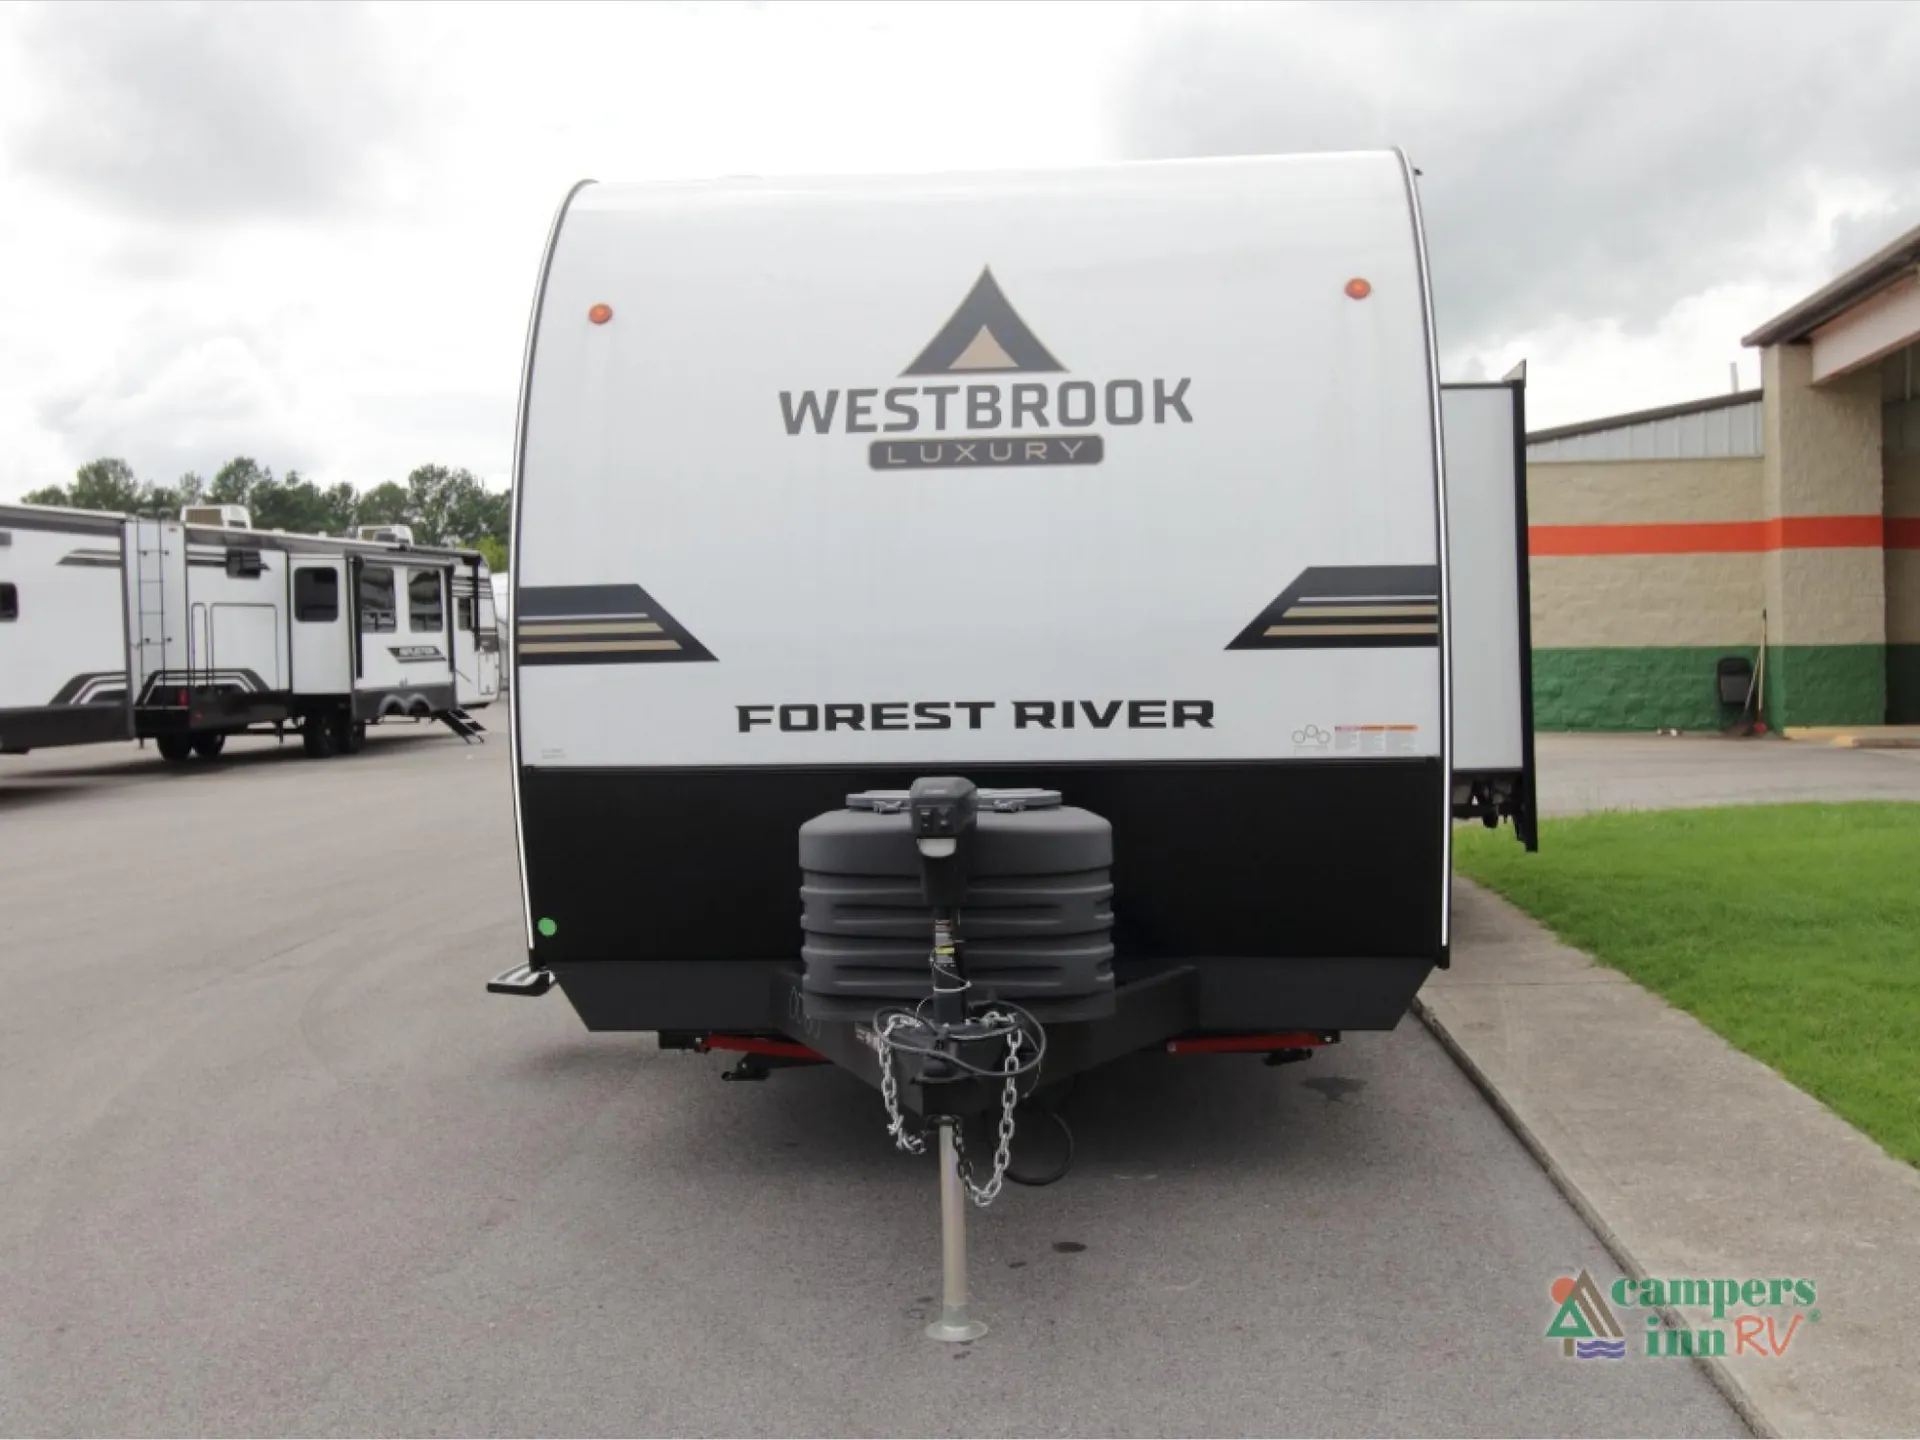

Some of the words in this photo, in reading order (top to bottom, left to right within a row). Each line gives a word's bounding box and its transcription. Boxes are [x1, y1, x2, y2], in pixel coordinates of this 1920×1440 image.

[779, 378, 1193, 435] WESTBROOK
[886, 440, 1083, 464] LUXURY
[735, 701, 996, 733] FOREST
[1011, 699, 1214, 730] RIVER
